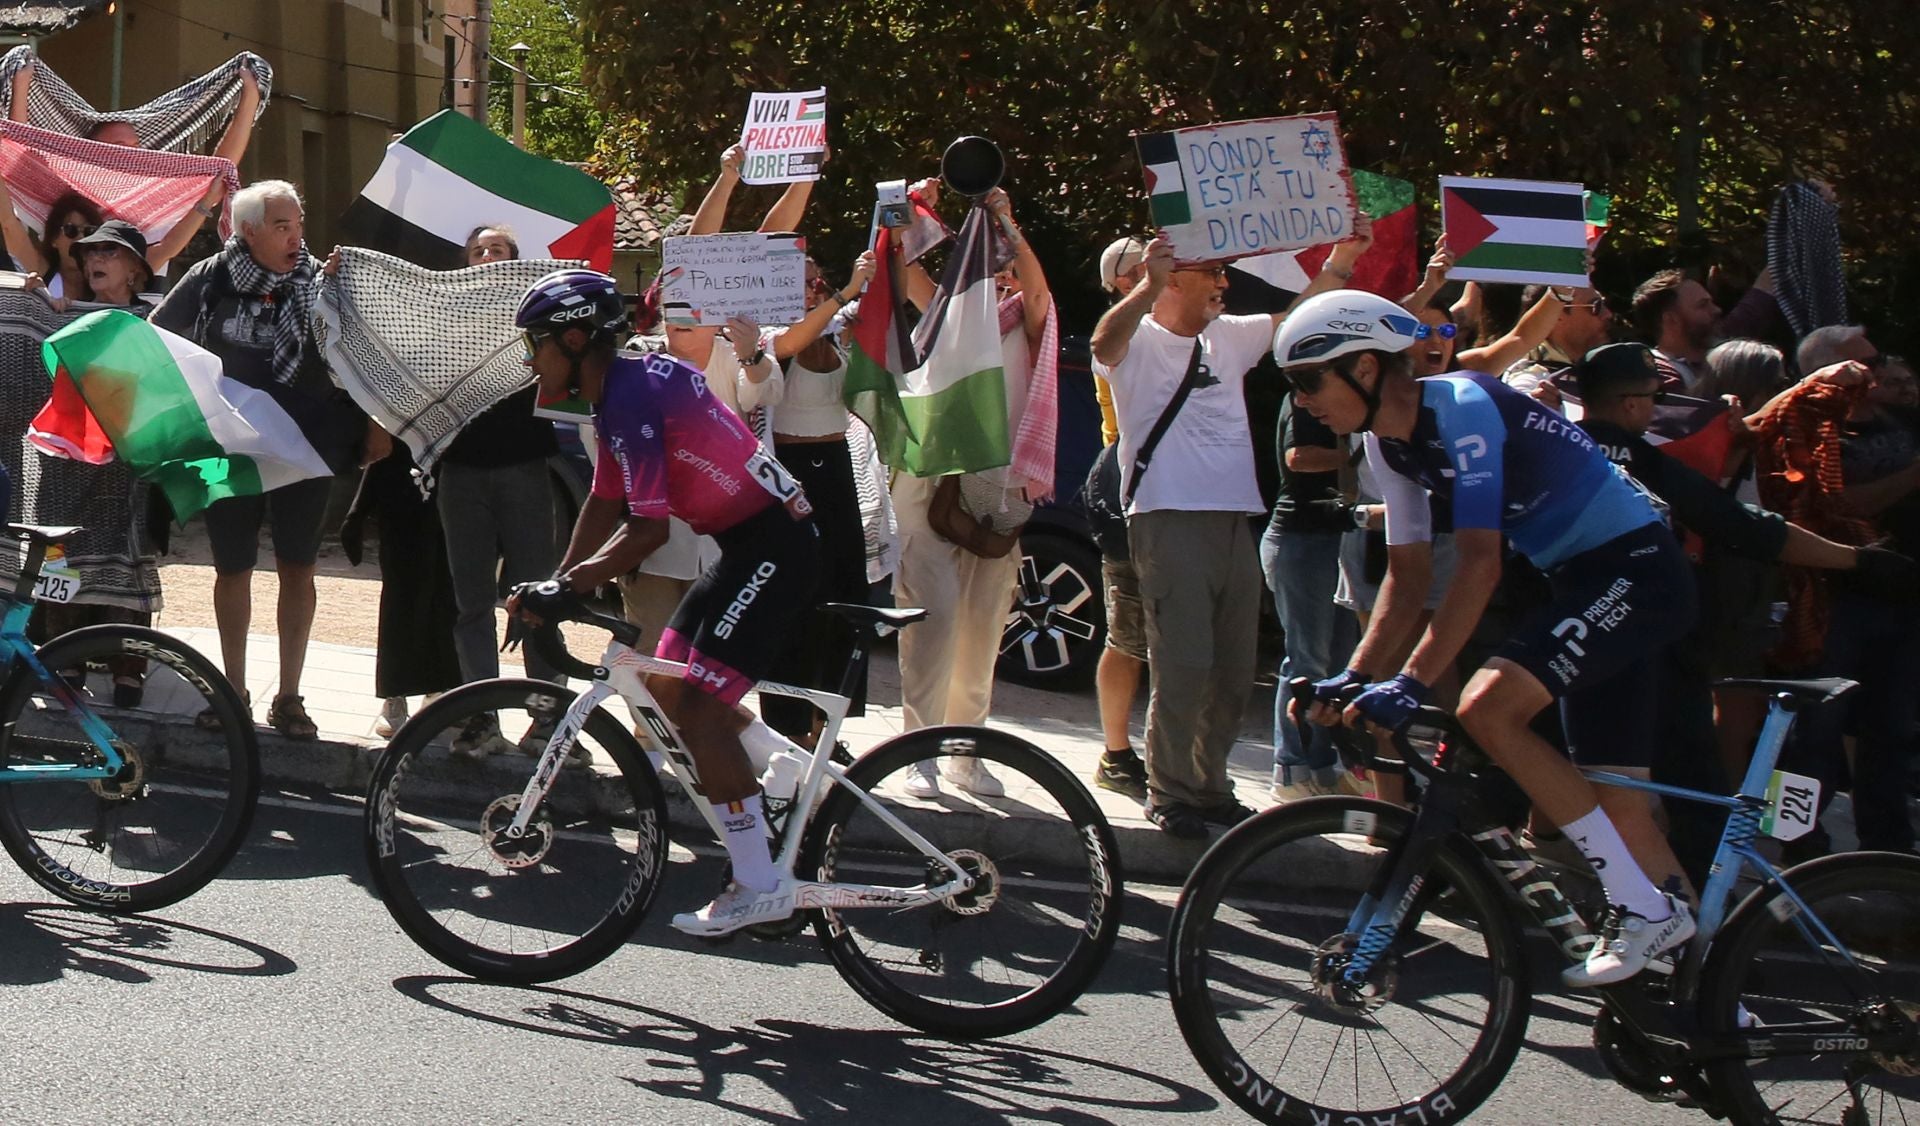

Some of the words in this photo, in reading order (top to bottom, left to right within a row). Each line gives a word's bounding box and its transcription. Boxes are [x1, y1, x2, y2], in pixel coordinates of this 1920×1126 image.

[754, 99, 790, 123] VIVA
[745, 123, 826, 151] PALESTINA
[744, 154, 786, 179] IBRE
[1276, 169, 1315, 199] TU
[1207, 203, 1344, 250] DIGNIDAD
[688, 269, 765, 290] PALESTINA
[1523, 411, 1594, 452] FACTOR
[39, 576, 71, 601] 125
[714, 561, 777, 640] SIROKO
[1583, 577, 1633, 622] PREMIER
[1597, 601, 1632, 632] TECH
[688, 662, 728, 689] BH
[1780, 785, 1814, 825] 224
[1813, 1038, 1869, 1050] OSTRO
